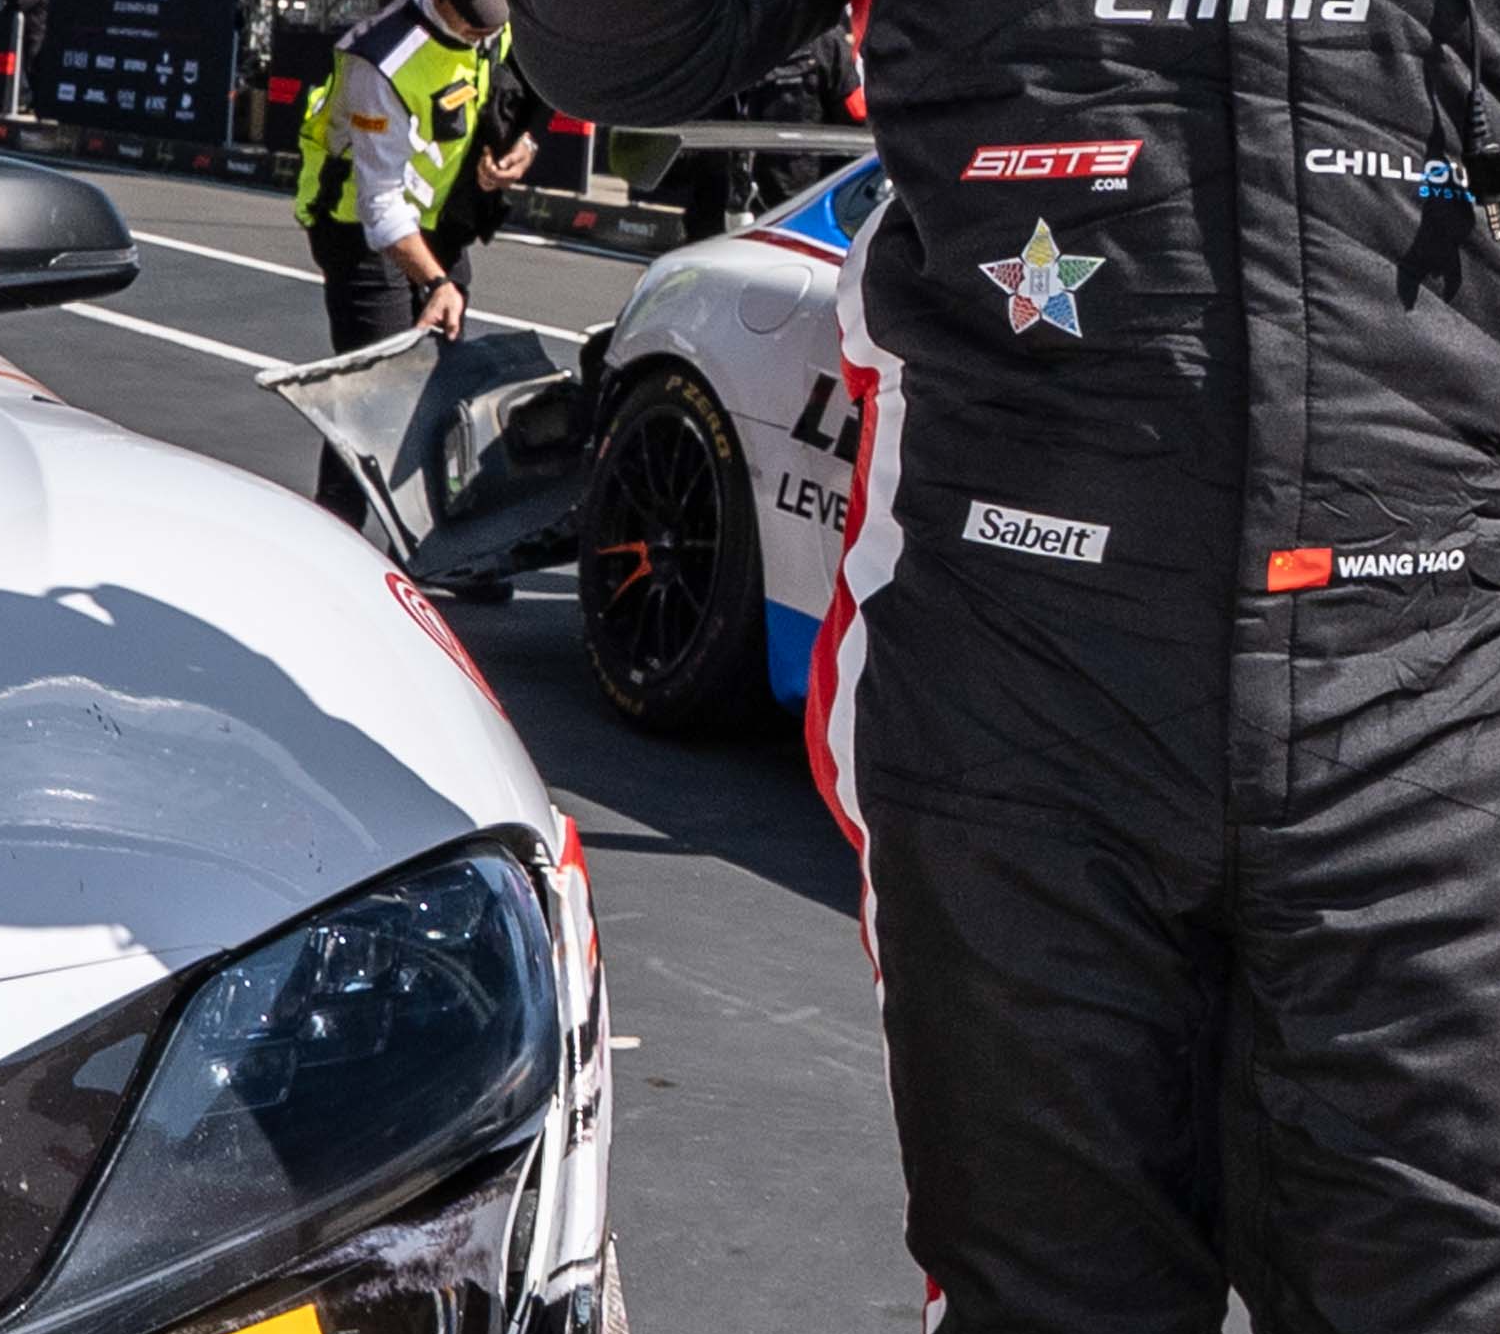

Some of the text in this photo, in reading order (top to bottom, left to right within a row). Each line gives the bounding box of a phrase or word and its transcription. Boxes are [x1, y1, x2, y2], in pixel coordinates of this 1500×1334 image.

[1090, 178, 1128, 191] .COM
[1305, 148, 1469, 188] CHILLOU
[775, 472, 849, 535] LEVE
[978, 507, 1097, 557] Sabelt
[1337, 549, 1466, 578] WANG HAO
